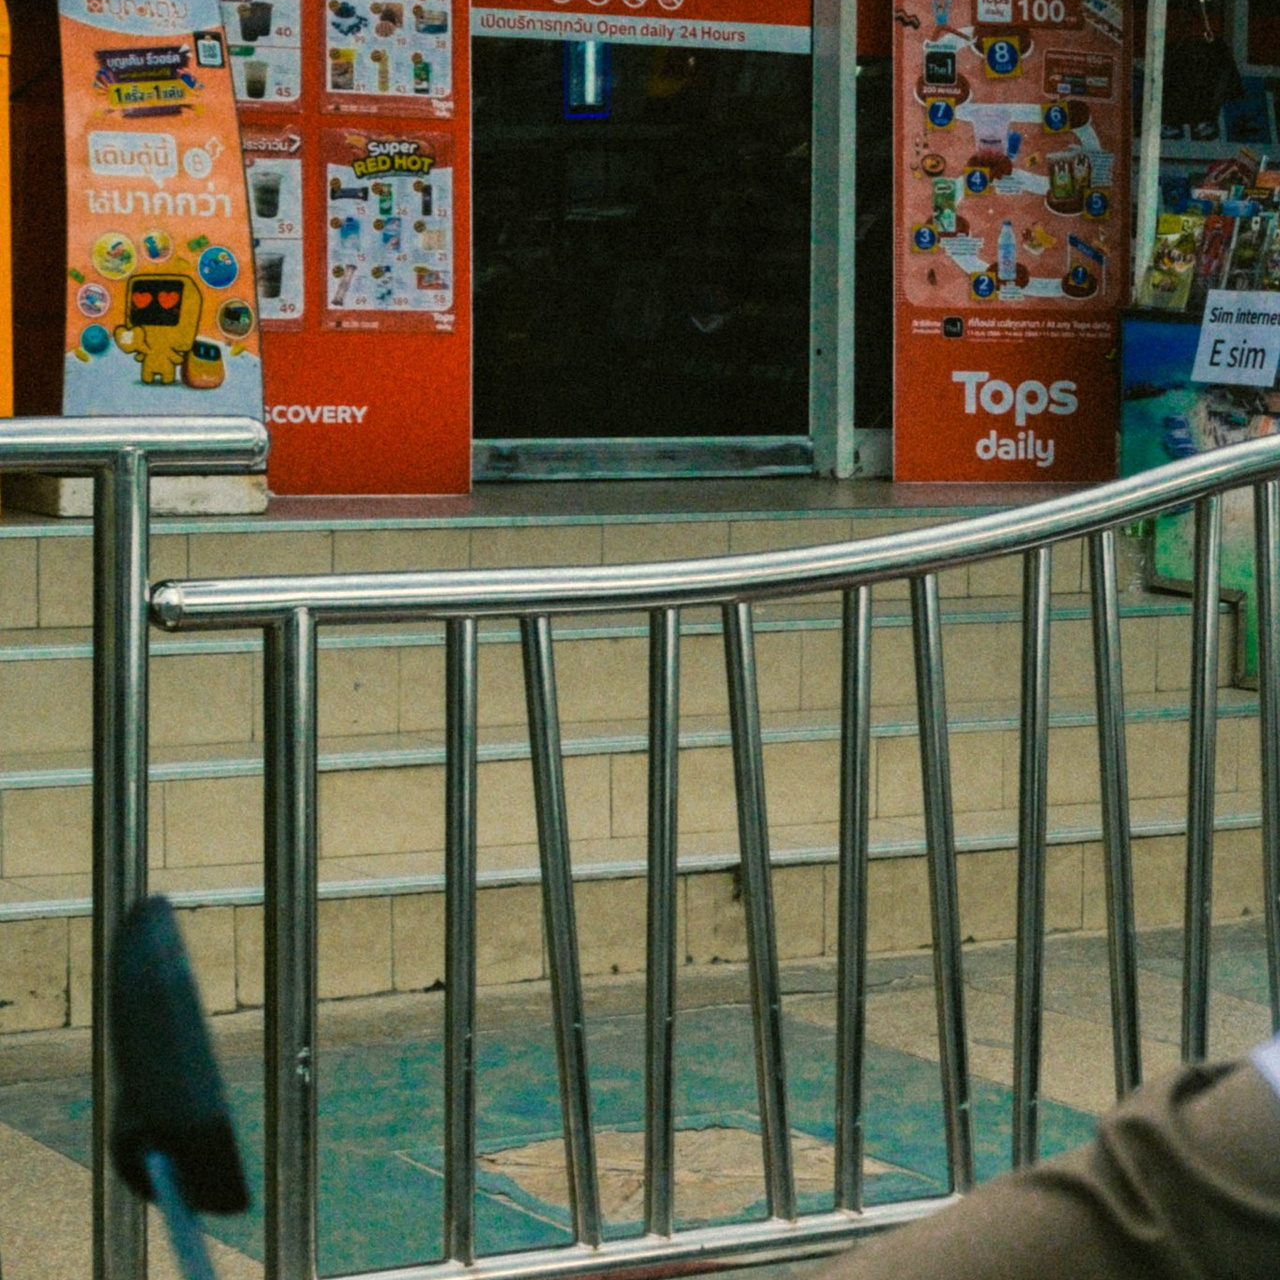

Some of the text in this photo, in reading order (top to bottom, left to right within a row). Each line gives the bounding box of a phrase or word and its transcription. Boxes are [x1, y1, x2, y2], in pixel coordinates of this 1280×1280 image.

[480, 14, 746, 43] เปิดบริการทุกวัน Open daily 24 Hours
[994, 40, 1009, 63] 8
[935, 101, 946, 118] 7
[1050, 107, 1061, 122] 6
[94, 137, 170, 174] เติมตู้นี้
[367, 142, 418, 157] Super
[353, 156, 434, 175] RED HOT
[970, 171, 982, 186] 4
[85, 181, 233, 219] ได้มากกว่า
[1091, 195, 1103, 210] 5
[919, 227, 931, 243] 3
[978, 275, 989, 290] 2
[1209, 306, 1234, 324] Sim
[1209, 339, 1266, 370] E sim
[951, 370, 1079, 427] Tops
[975, 429, 1055, 468] daily
